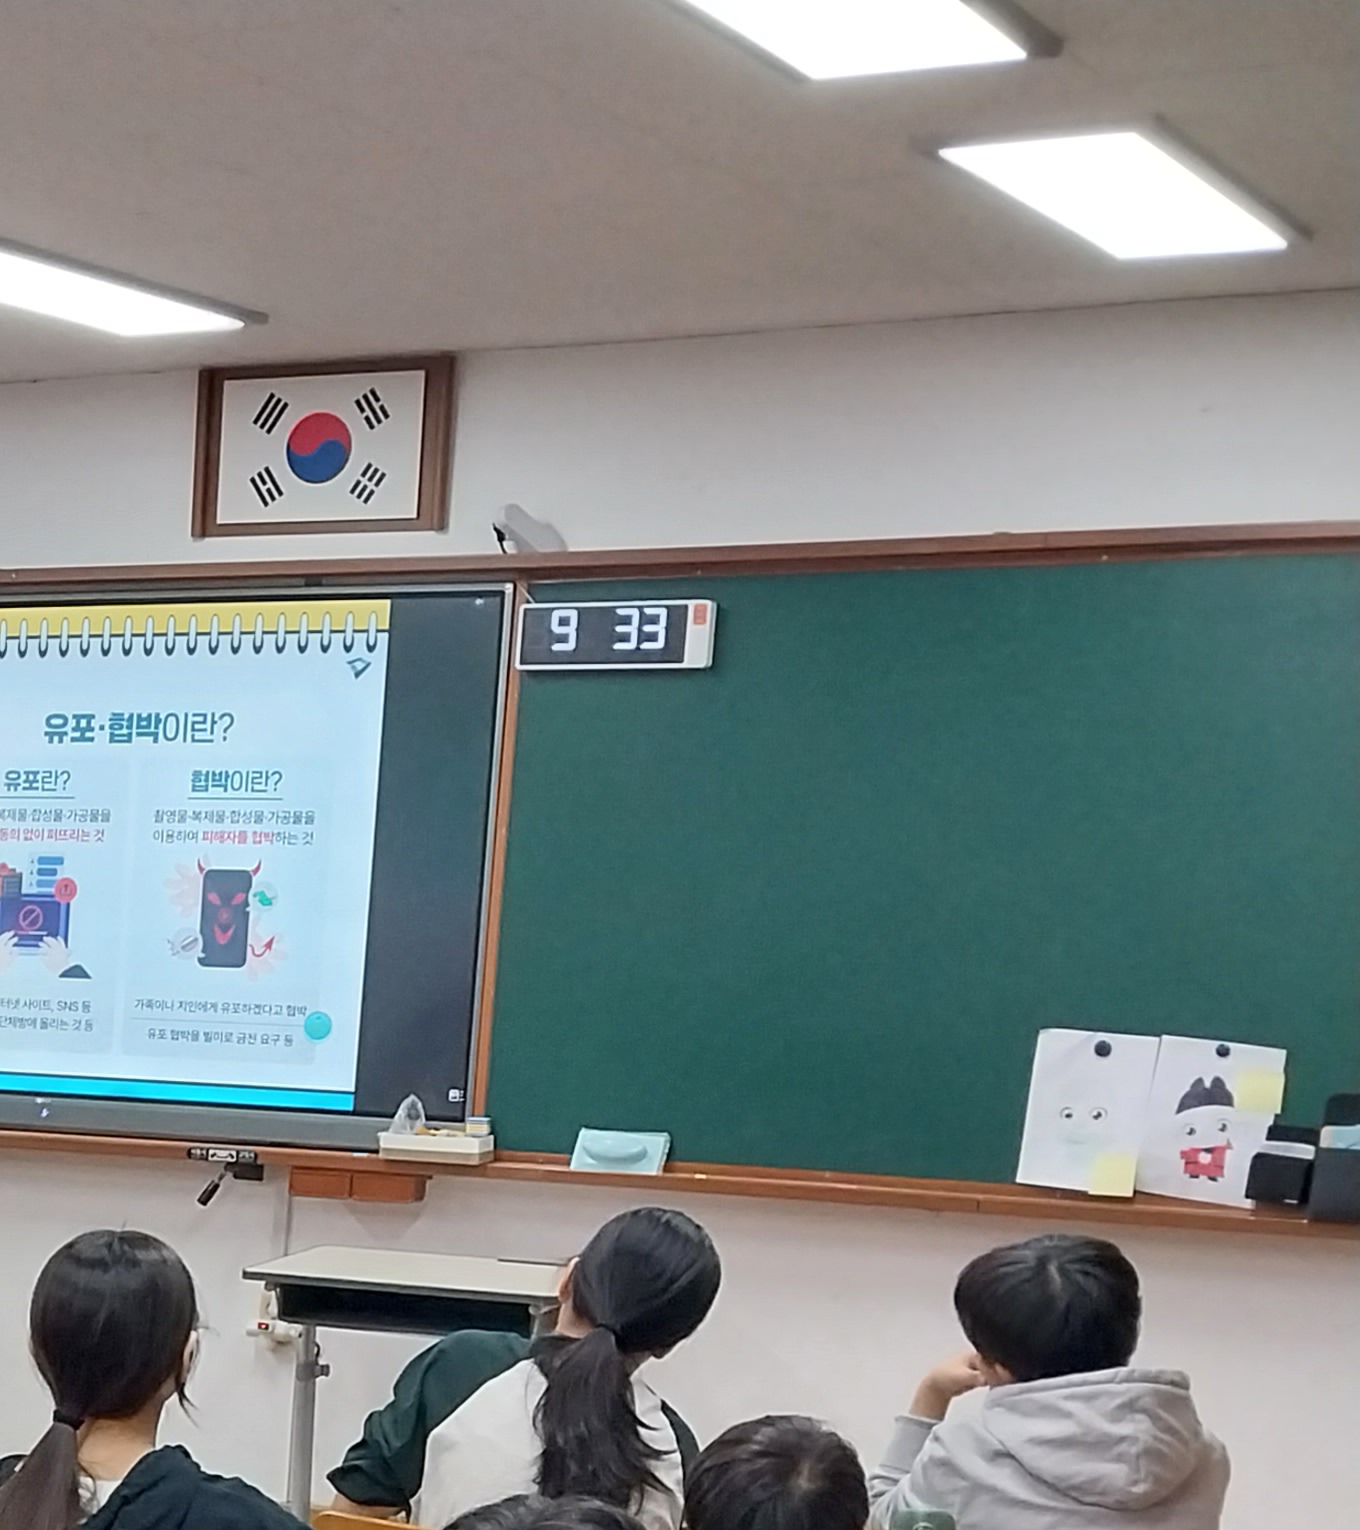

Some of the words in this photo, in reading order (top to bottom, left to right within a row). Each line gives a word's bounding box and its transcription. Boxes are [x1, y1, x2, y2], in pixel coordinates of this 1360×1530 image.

[550, 608, 579, 651] 9
[612, 607, 669, 650] 33
[3, 770, 71, 792] 유포란?
[190, 770, 283, 793] 협박이란?
[0, 828, 20, 841] 동의
[22, 828, 44, 841] 없이
[94, 829, 105, 843] 것
[152, 829, 199, 843] 이용하여
[202, 830, 248, 844] 피해자를
[251, 830, 299, 845] 협박하는
[302, 831, 314, 846] 것
[56, 1000, 79, 1012] SNS
[81, 1000, 92, 1014] 등
[134, 998, 175, 1012] 가족이나
[177, 1000, 218, 1014] 지인에게
[220, 1001, 283, 1016] 유포하겠다고
[286, 1004, 308, 1018] 협박
[71, 1018, 81, 1032] 것
[84, 1019, 94, 1032] 등
[146, 1027, 168, 1040] 유포
[284, 1034, 294, 1047] 등
